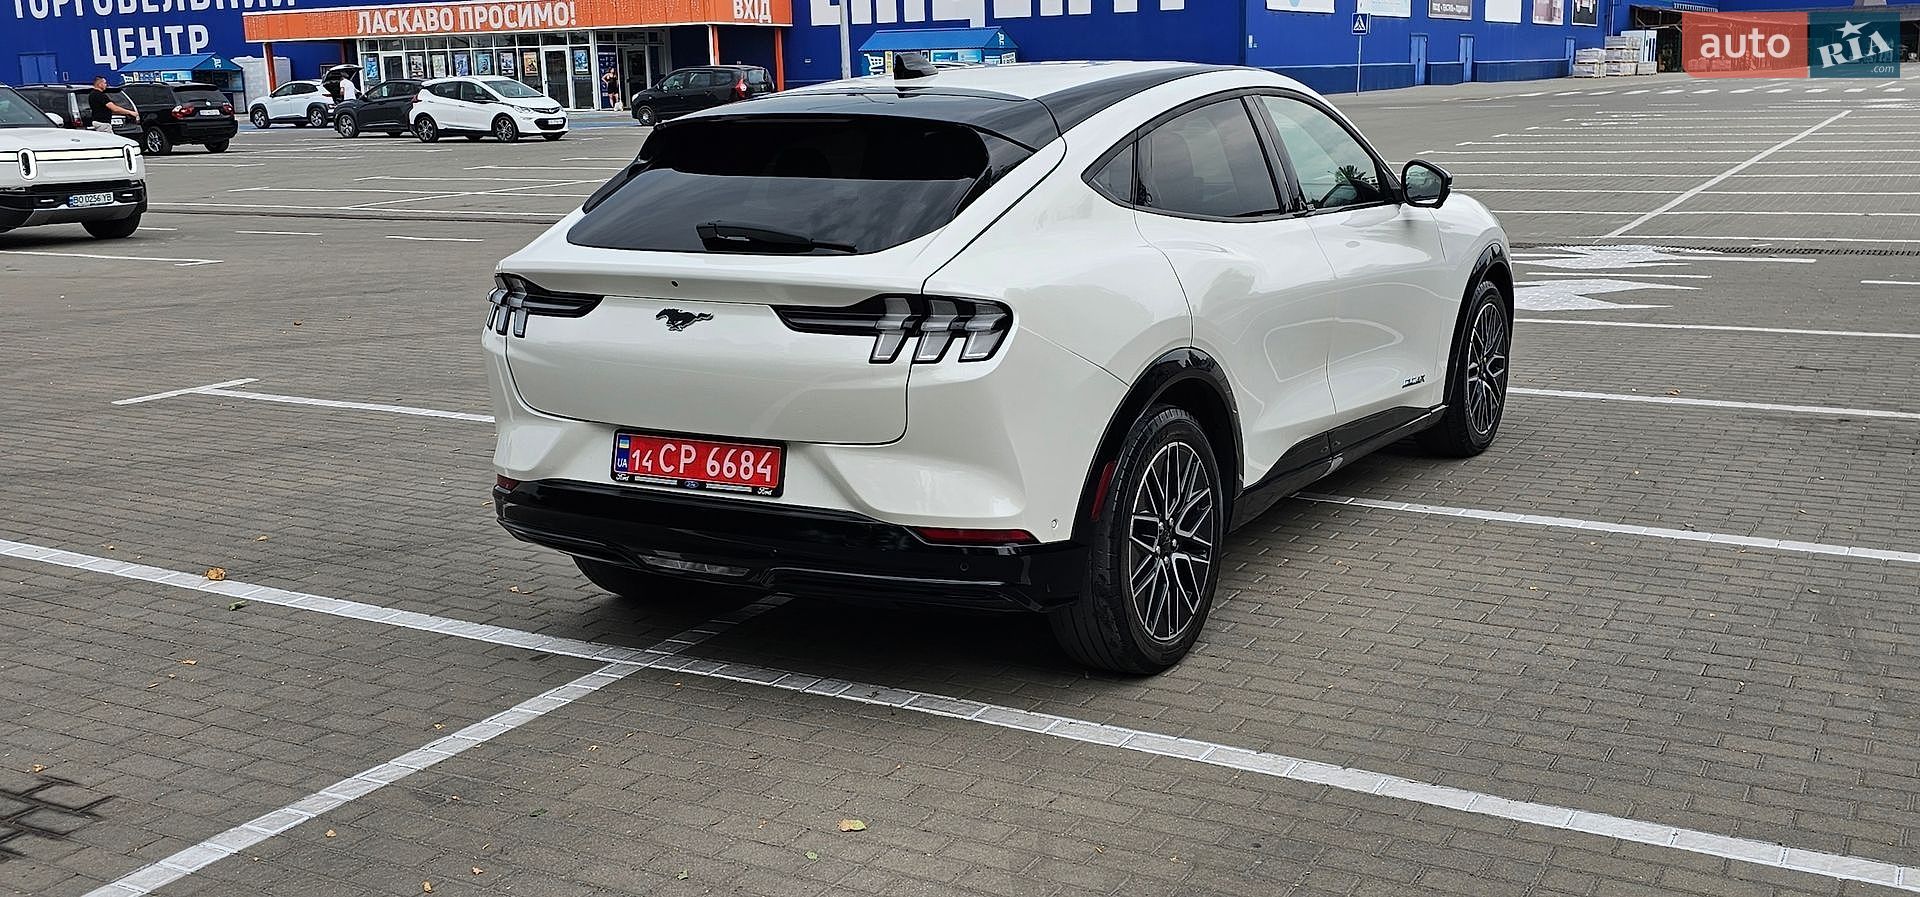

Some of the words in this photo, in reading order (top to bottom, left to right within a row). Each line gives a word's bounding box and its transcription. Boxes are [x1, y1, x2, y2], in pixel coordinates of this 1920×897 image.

[357, 8, 454, 33] ЛАСКАВО
[459, 0, 577, 31] ПРОСИМО!
[732, 0, 772, 24] ВХІД
[90, 24, 210, 71] ЦЕНТР
[617, 458, 628, 468] UA
[632, 449, 653, 472] 14
[659, 443, 697, 474] CP
[706, 447, 772, 482] 6684
